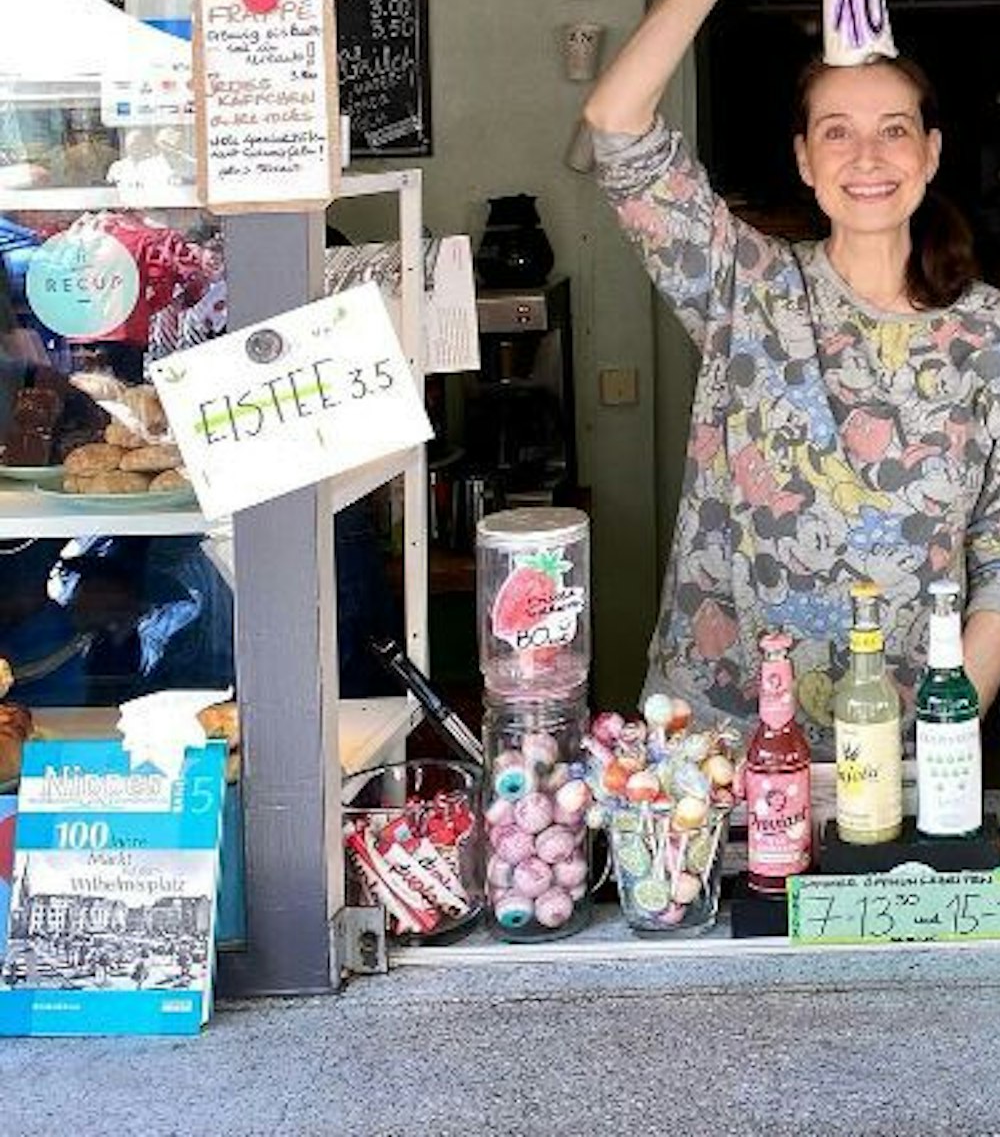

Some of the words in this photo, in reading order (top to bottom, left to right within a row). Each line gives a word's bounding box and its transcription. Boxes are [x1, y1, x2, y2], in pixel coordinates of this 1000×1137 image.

[45, 274, 124, 294] RECUP
[199, 357, 342, 445] EISTEE
[348, 358, 394, 401] 3.5
[190, 775, 214, 815] 5
[55, 821, 109, 849] 100
